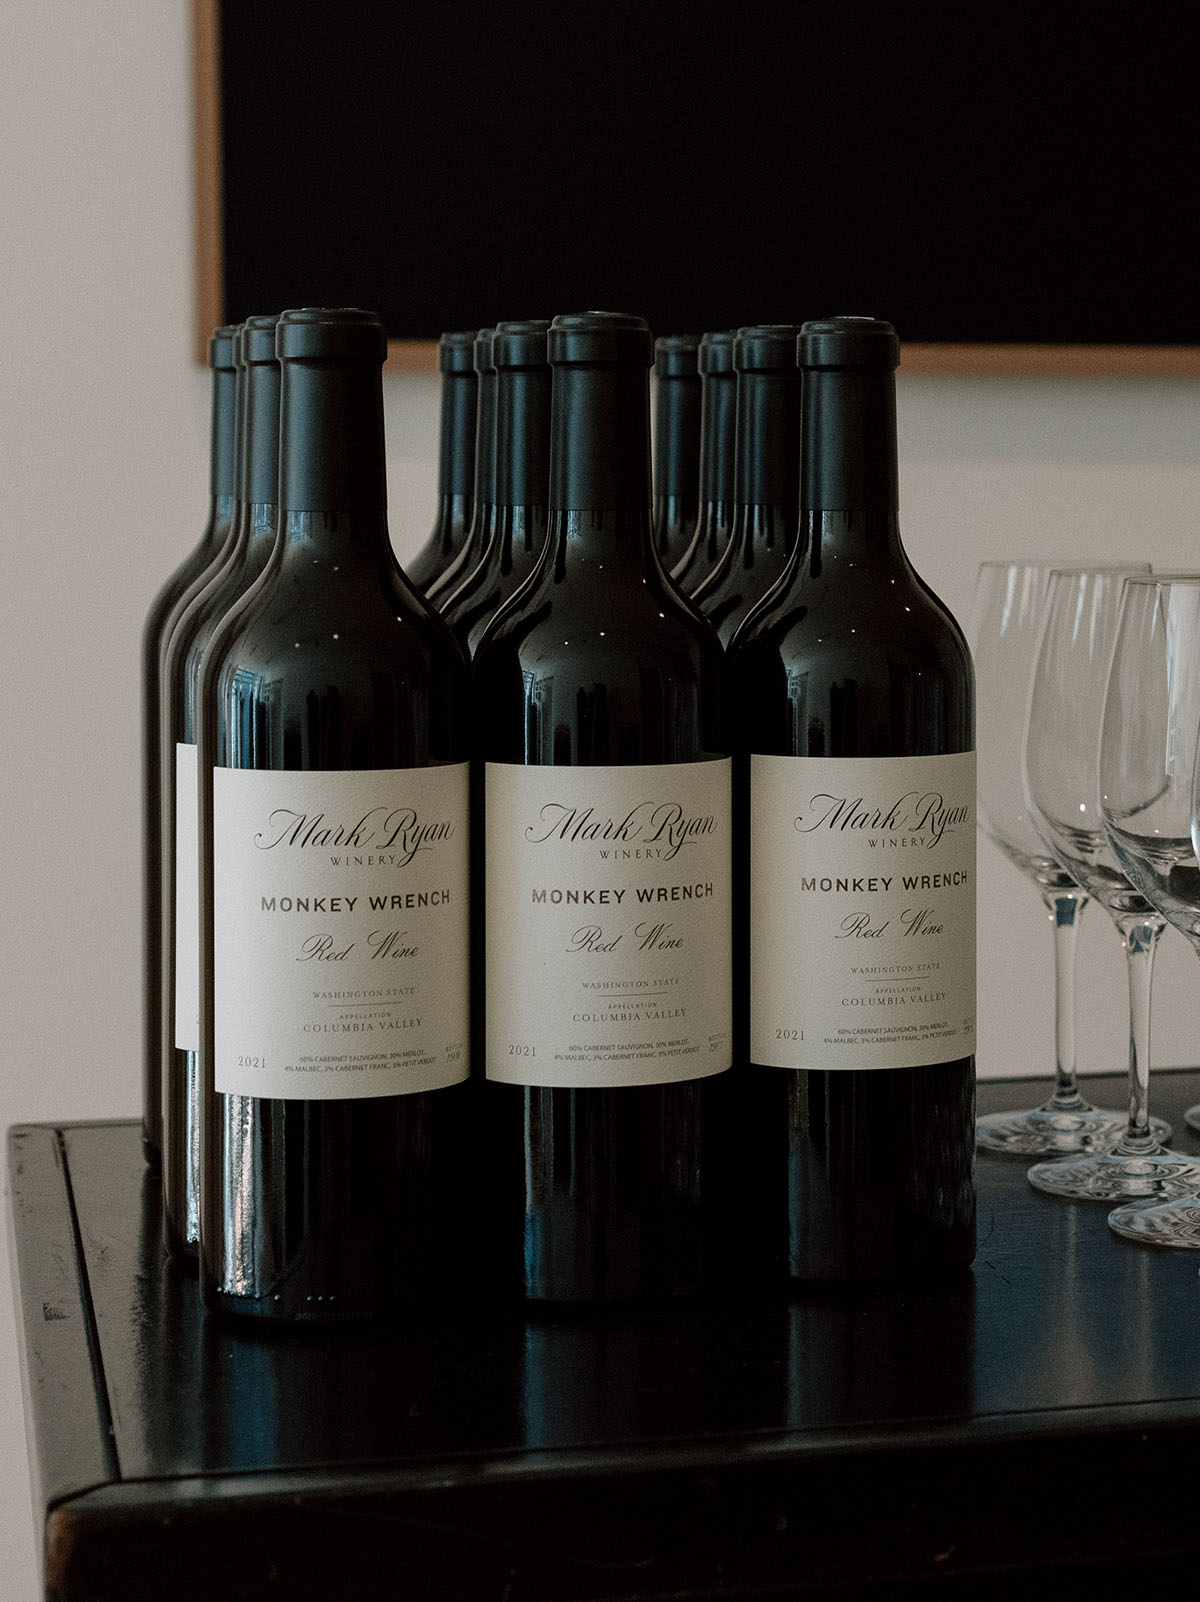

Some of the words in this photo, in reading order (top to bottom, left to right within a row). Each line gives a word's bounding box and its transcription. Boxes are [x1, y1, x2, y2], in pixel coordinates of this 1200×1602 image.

[793, 791, 919, 832] Mark
[908, 792, 970, 849] Ryan
[254, 807, 387, 849] Mark
[376, 807, 456, 868] Ryan
[525, 801, 655, 843] Mark
[643, 802, 719, 861] Ryan
[868, 837, 926, 848] WINERY
[330, 855, 396, 866] WINERY
[599, 848, 663, 860] WINERY
[801, 877, 893, 892] MONKEY
[902, 870, 967, 890] WRENCH
[261, 897, 358, 912] MONKEY
[369, 889, 450, 910] WRENCH
[532, 889, 625, 904] MONKEY
[636, 882, 713, 903] WRENCH
[835, 911, 890, 939] Red
[900, 908, 944, 937] Wine
[565, 925, 623, 953] Red
[634, 922, 684, 951] Wine
[296, 933, 355, 961] Red
[367, 930, 419, 960] Wine
[850, 965, 913, 974] WASHINGTON
[917, 962, 940, 970] STATE
[582, 980, 649, 989] WASHINGTON
[653, 978, 679, 986] STATE
[313, 990, 382, 999] WASHINGTON
[386, 987, 415, 996] STATE
[841, 997, 906, 1007] COLUMBIA
[910, 992, 946, 1003] VALLEY
[572, 1013, 641, 1022] COLUMBIA
[645, 1008, 687, 1019] VALLEY
[303, 1023, 374, 1032] COLUMBIA
[379, 1017, 423, 1030] VALLEY
[776, 1029, 805, 1041] 2021
[508, 1045, 537, 1057] 2021
[237, 1055, 266, 1068] 2021
